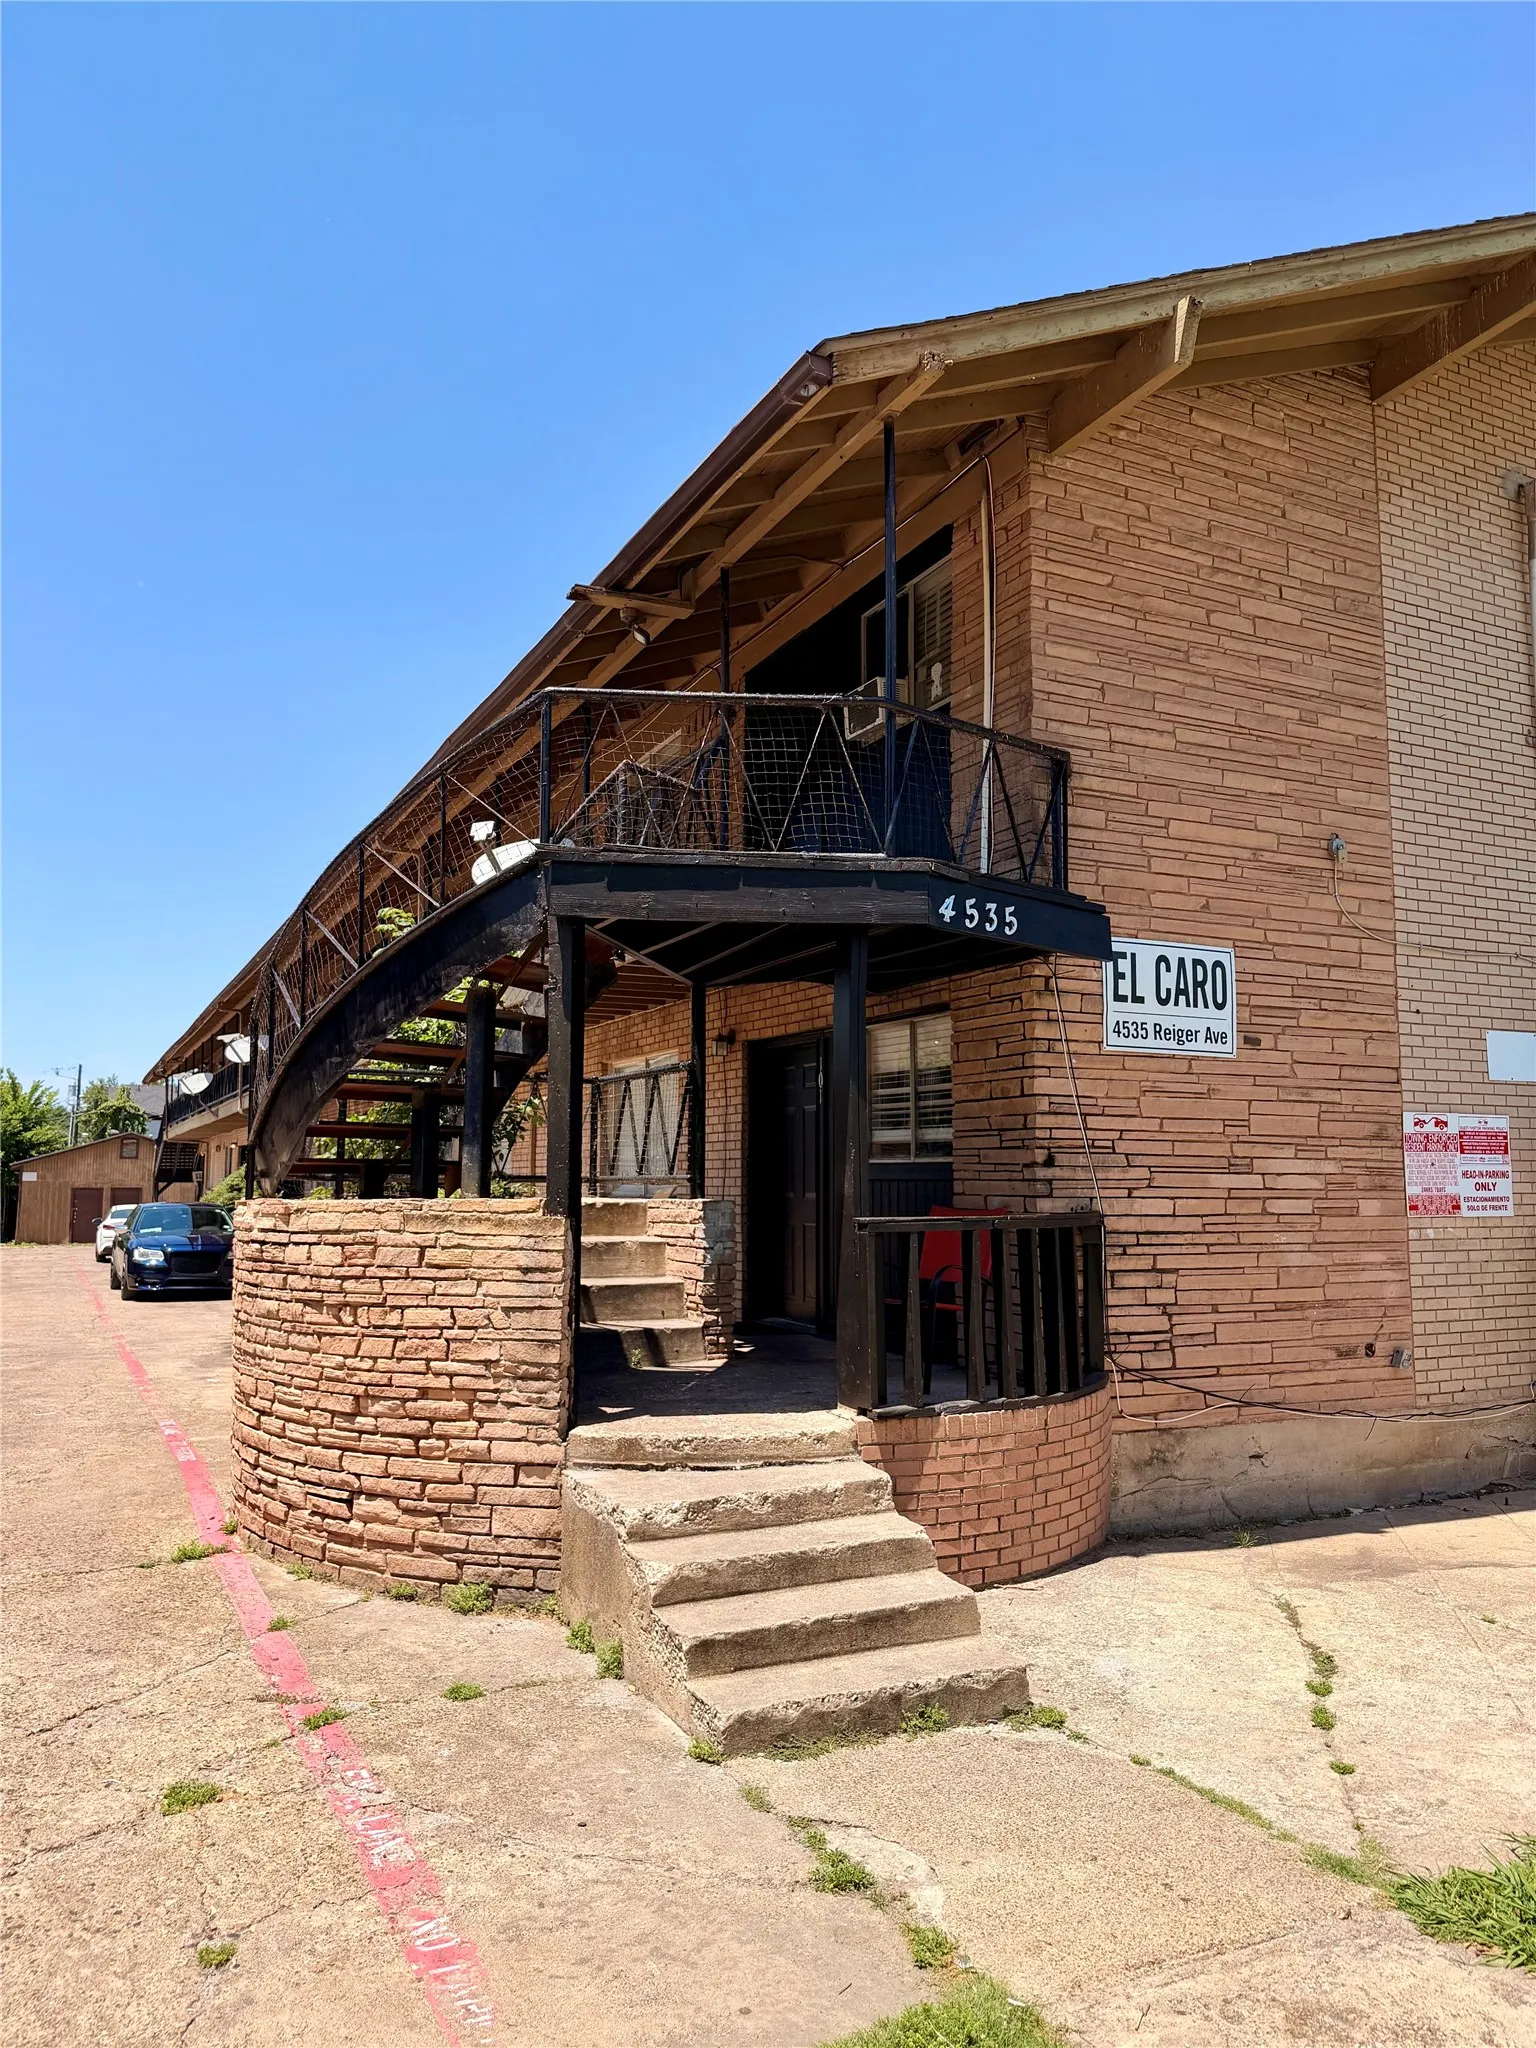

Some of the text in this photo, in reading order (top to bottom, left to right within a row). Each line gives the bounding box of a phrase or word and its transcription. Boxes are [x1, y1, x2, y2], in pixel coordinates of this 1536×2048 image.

[939, 894, 1018, 935] 4535
[1112, 951, 1228, 1011] EL CARO
[1112, 1020, 1228, 1046] 4535 Reiger Ave
[1405, 1133, 1458, 1143] TOWING ENFORCED
[1427, 1143, 1445, 1152] PARKING
[1446, 1143, 1458, 1152] ONLY
[1474, 1182, 1497, 1191] ONLY
